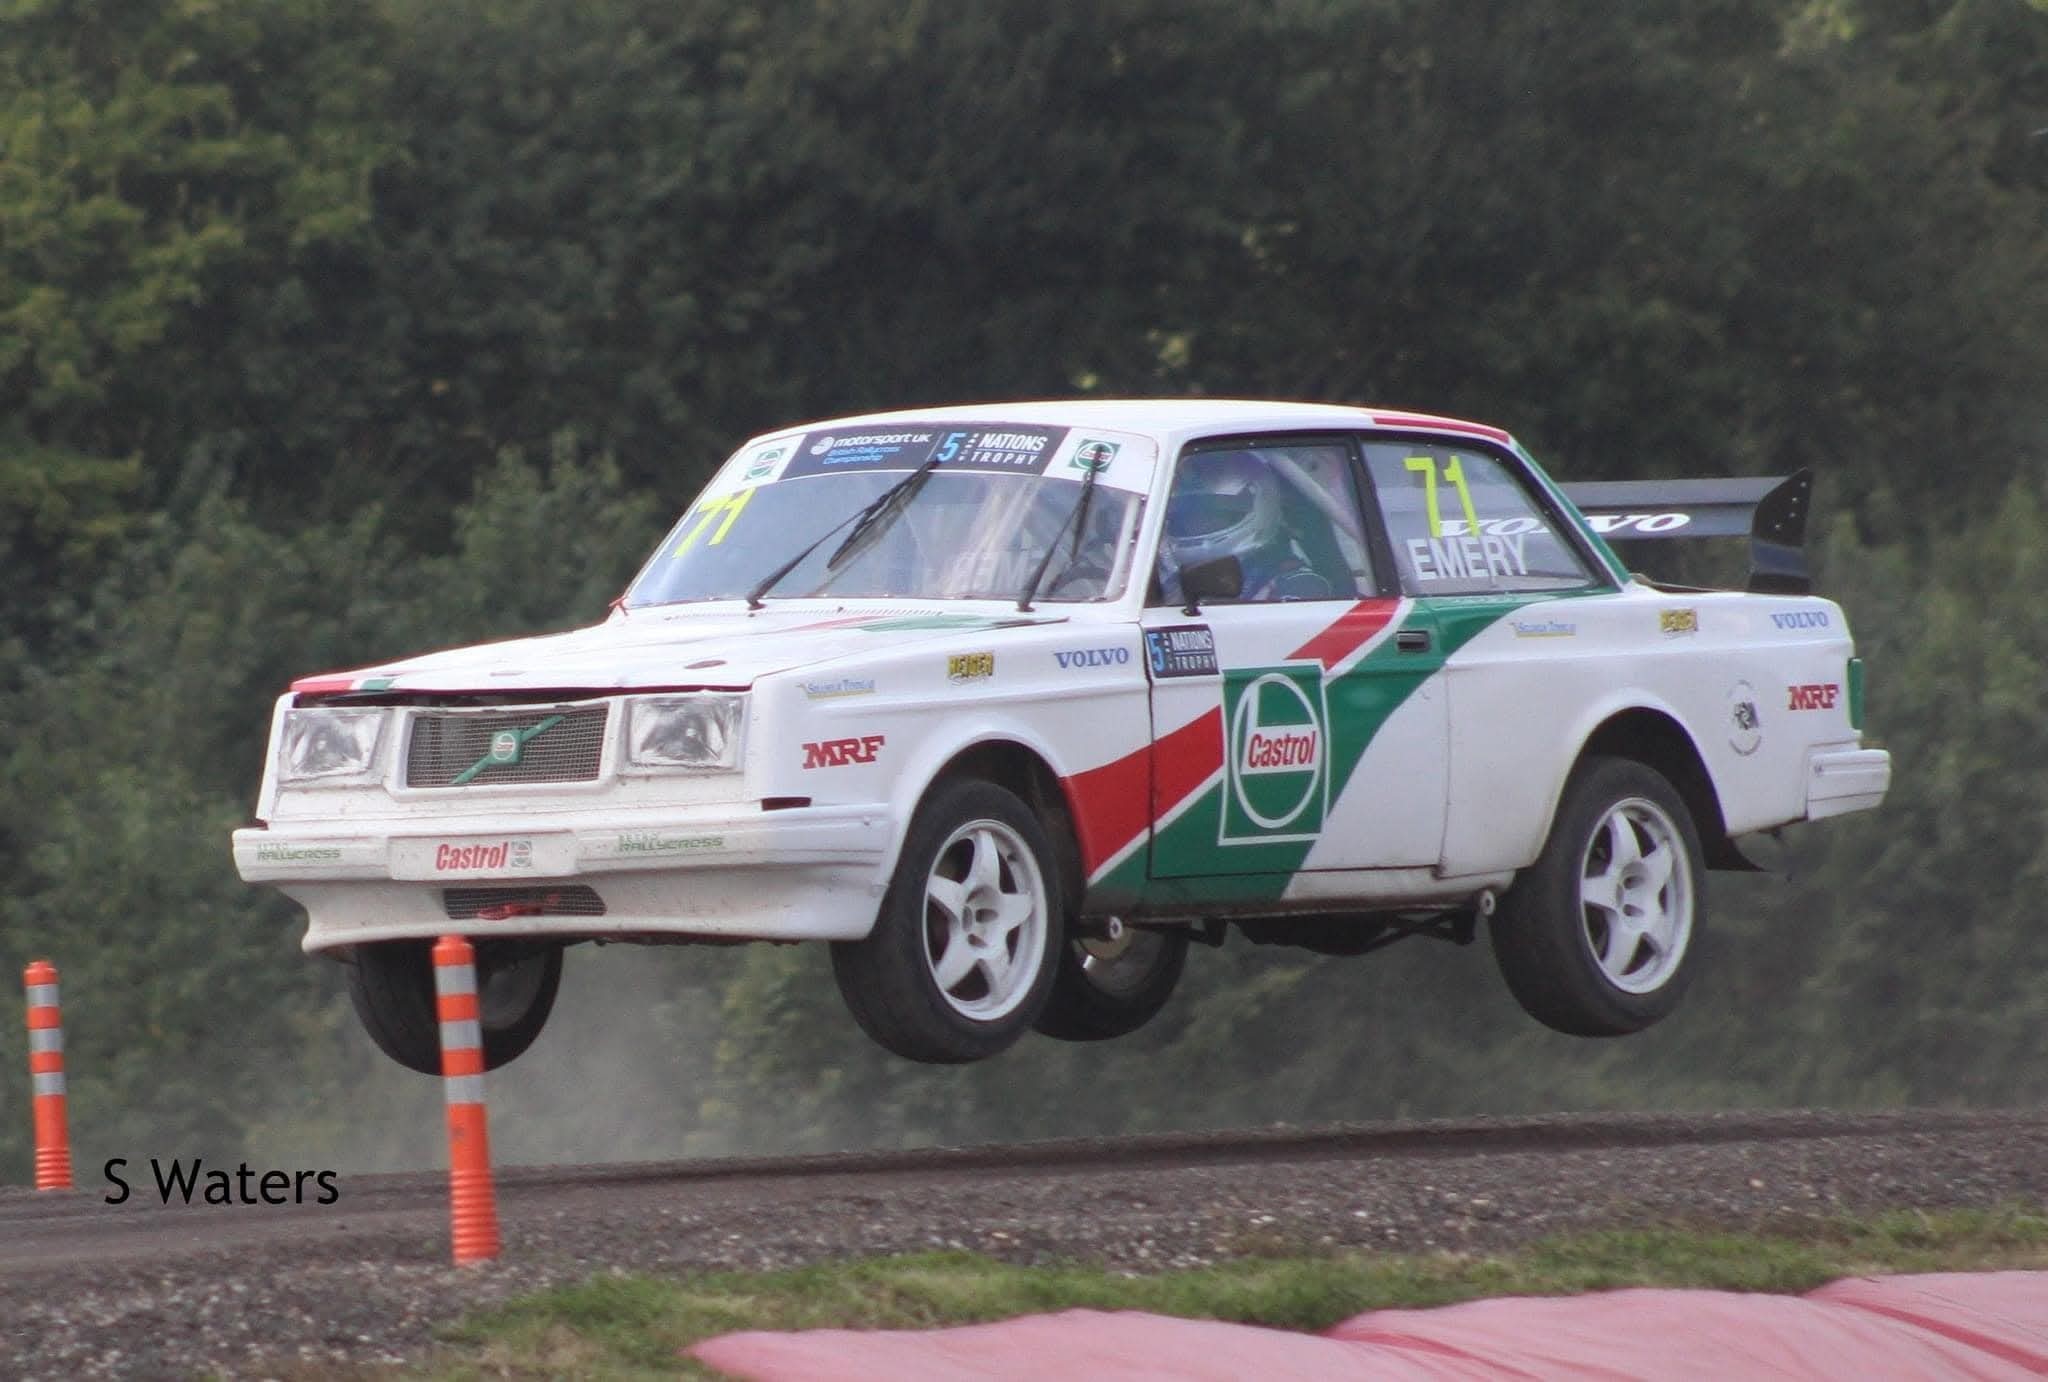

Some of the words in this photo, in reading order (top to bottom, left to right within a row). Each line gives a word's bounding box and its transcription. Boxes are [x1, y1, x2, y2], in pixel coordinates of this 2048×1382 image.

[833, 434, 912, 447] motorsport
[937, 432, 968, 462] 5
[977, 433, 1048, 451] NATIONS
[970, 451, 1038, 465] TROPHY
[1404, 455, 1481, 538] 71
[673, 487, 757, 558] 71
[1407, 534, 1527, 581] EMERY
[1770, 611, 1830, 630] VOLVO
[1054, 648, 1129, 669] VOLVO
[1146, 632, 1165, 672] 5
[1169, 630, 1213, 650] NATIONS
[1174, 655, 1216, 671] TROPHY
[1788, 684, 1839, 711] MRF
[802, 735, 884, 770] MRF
[1248, 730, 1317, 768] Castrol
[257, 848, 341, 860] RALLYCROSS
[436, 841, 508, 871] Castrol
[619, 837, 724, 852] RALLYCROSS
